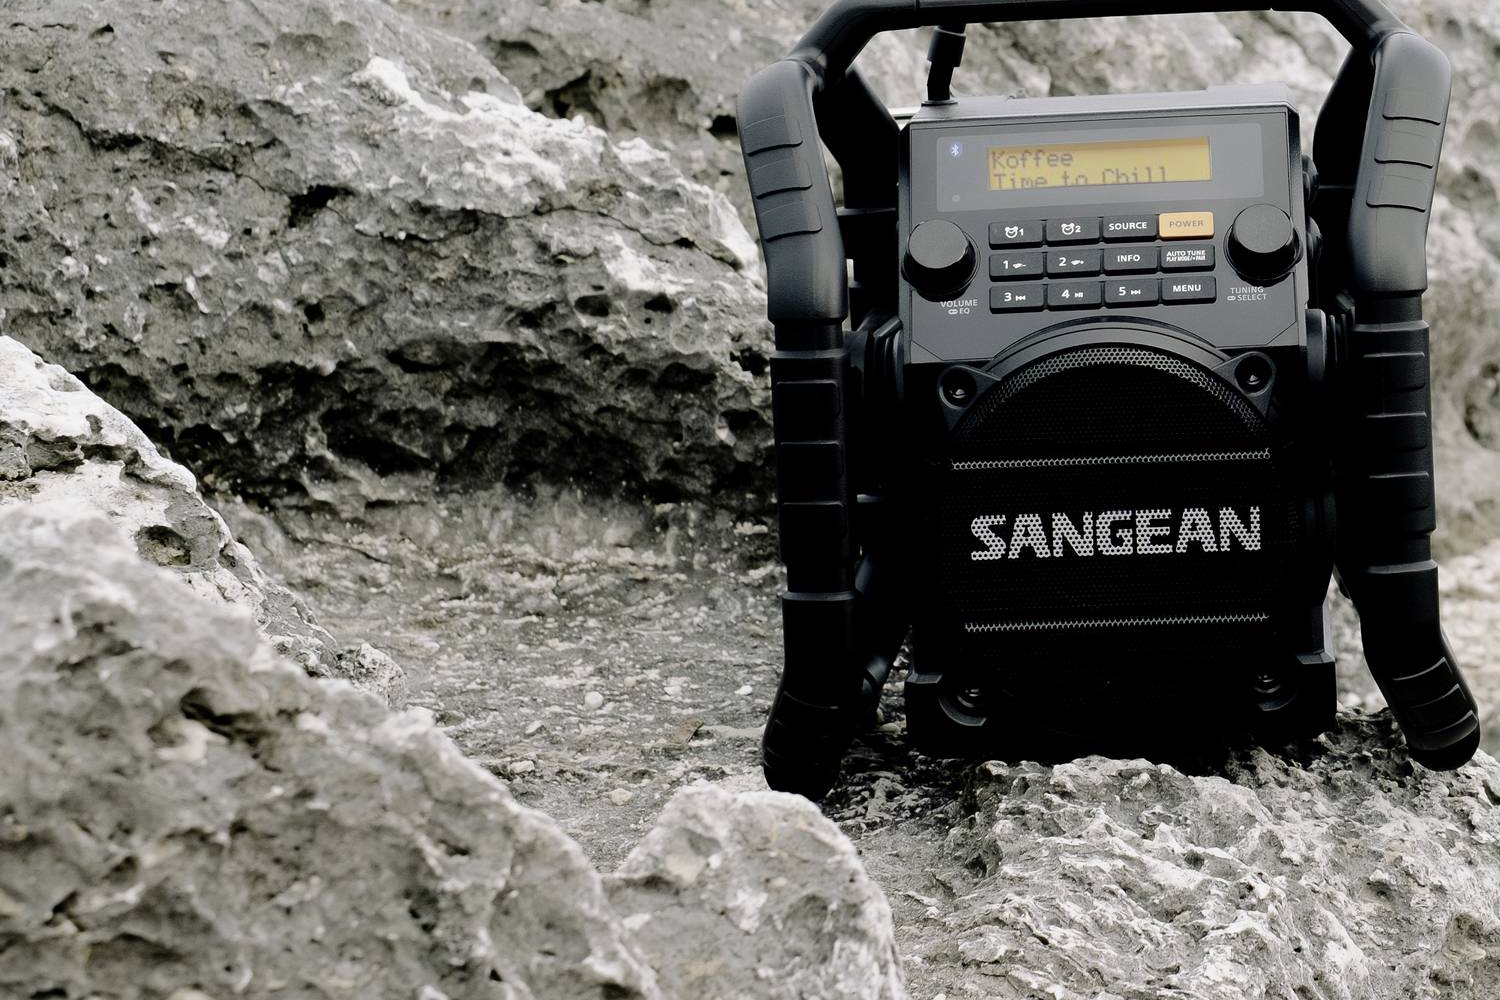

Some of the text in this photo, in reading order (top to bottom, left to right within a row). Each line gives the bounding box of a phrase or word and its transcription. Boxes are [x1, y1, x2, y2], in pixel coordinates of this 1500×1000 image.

[992, 149, 1074, 170] Koffee
[993, 166, 1168, 189] Time to Chill
[1108, 221, 1148, 231] SOURCE
[1169, 219, 1204, 228] POWER
[1059, 257, 1067, 267] 2
[1117, 254, 1141, 263] INFO
[1003, 260, 1009, 269] 1
[1118, 286, 1127, 296] 5
[1172, 284, 1202, 293] MENU
[1230, 286, 1264, 294] TUNING
[1004, 292, 1012, 302] 3
[1061, 289, 1070, 299] 4
[1237, 293, 1268, 302] SELECT
[940, 299, 979, 308] VOLUME
[959, 307, 970, 315] EQ
[970, 506, 1261, 561] SANGEAN
